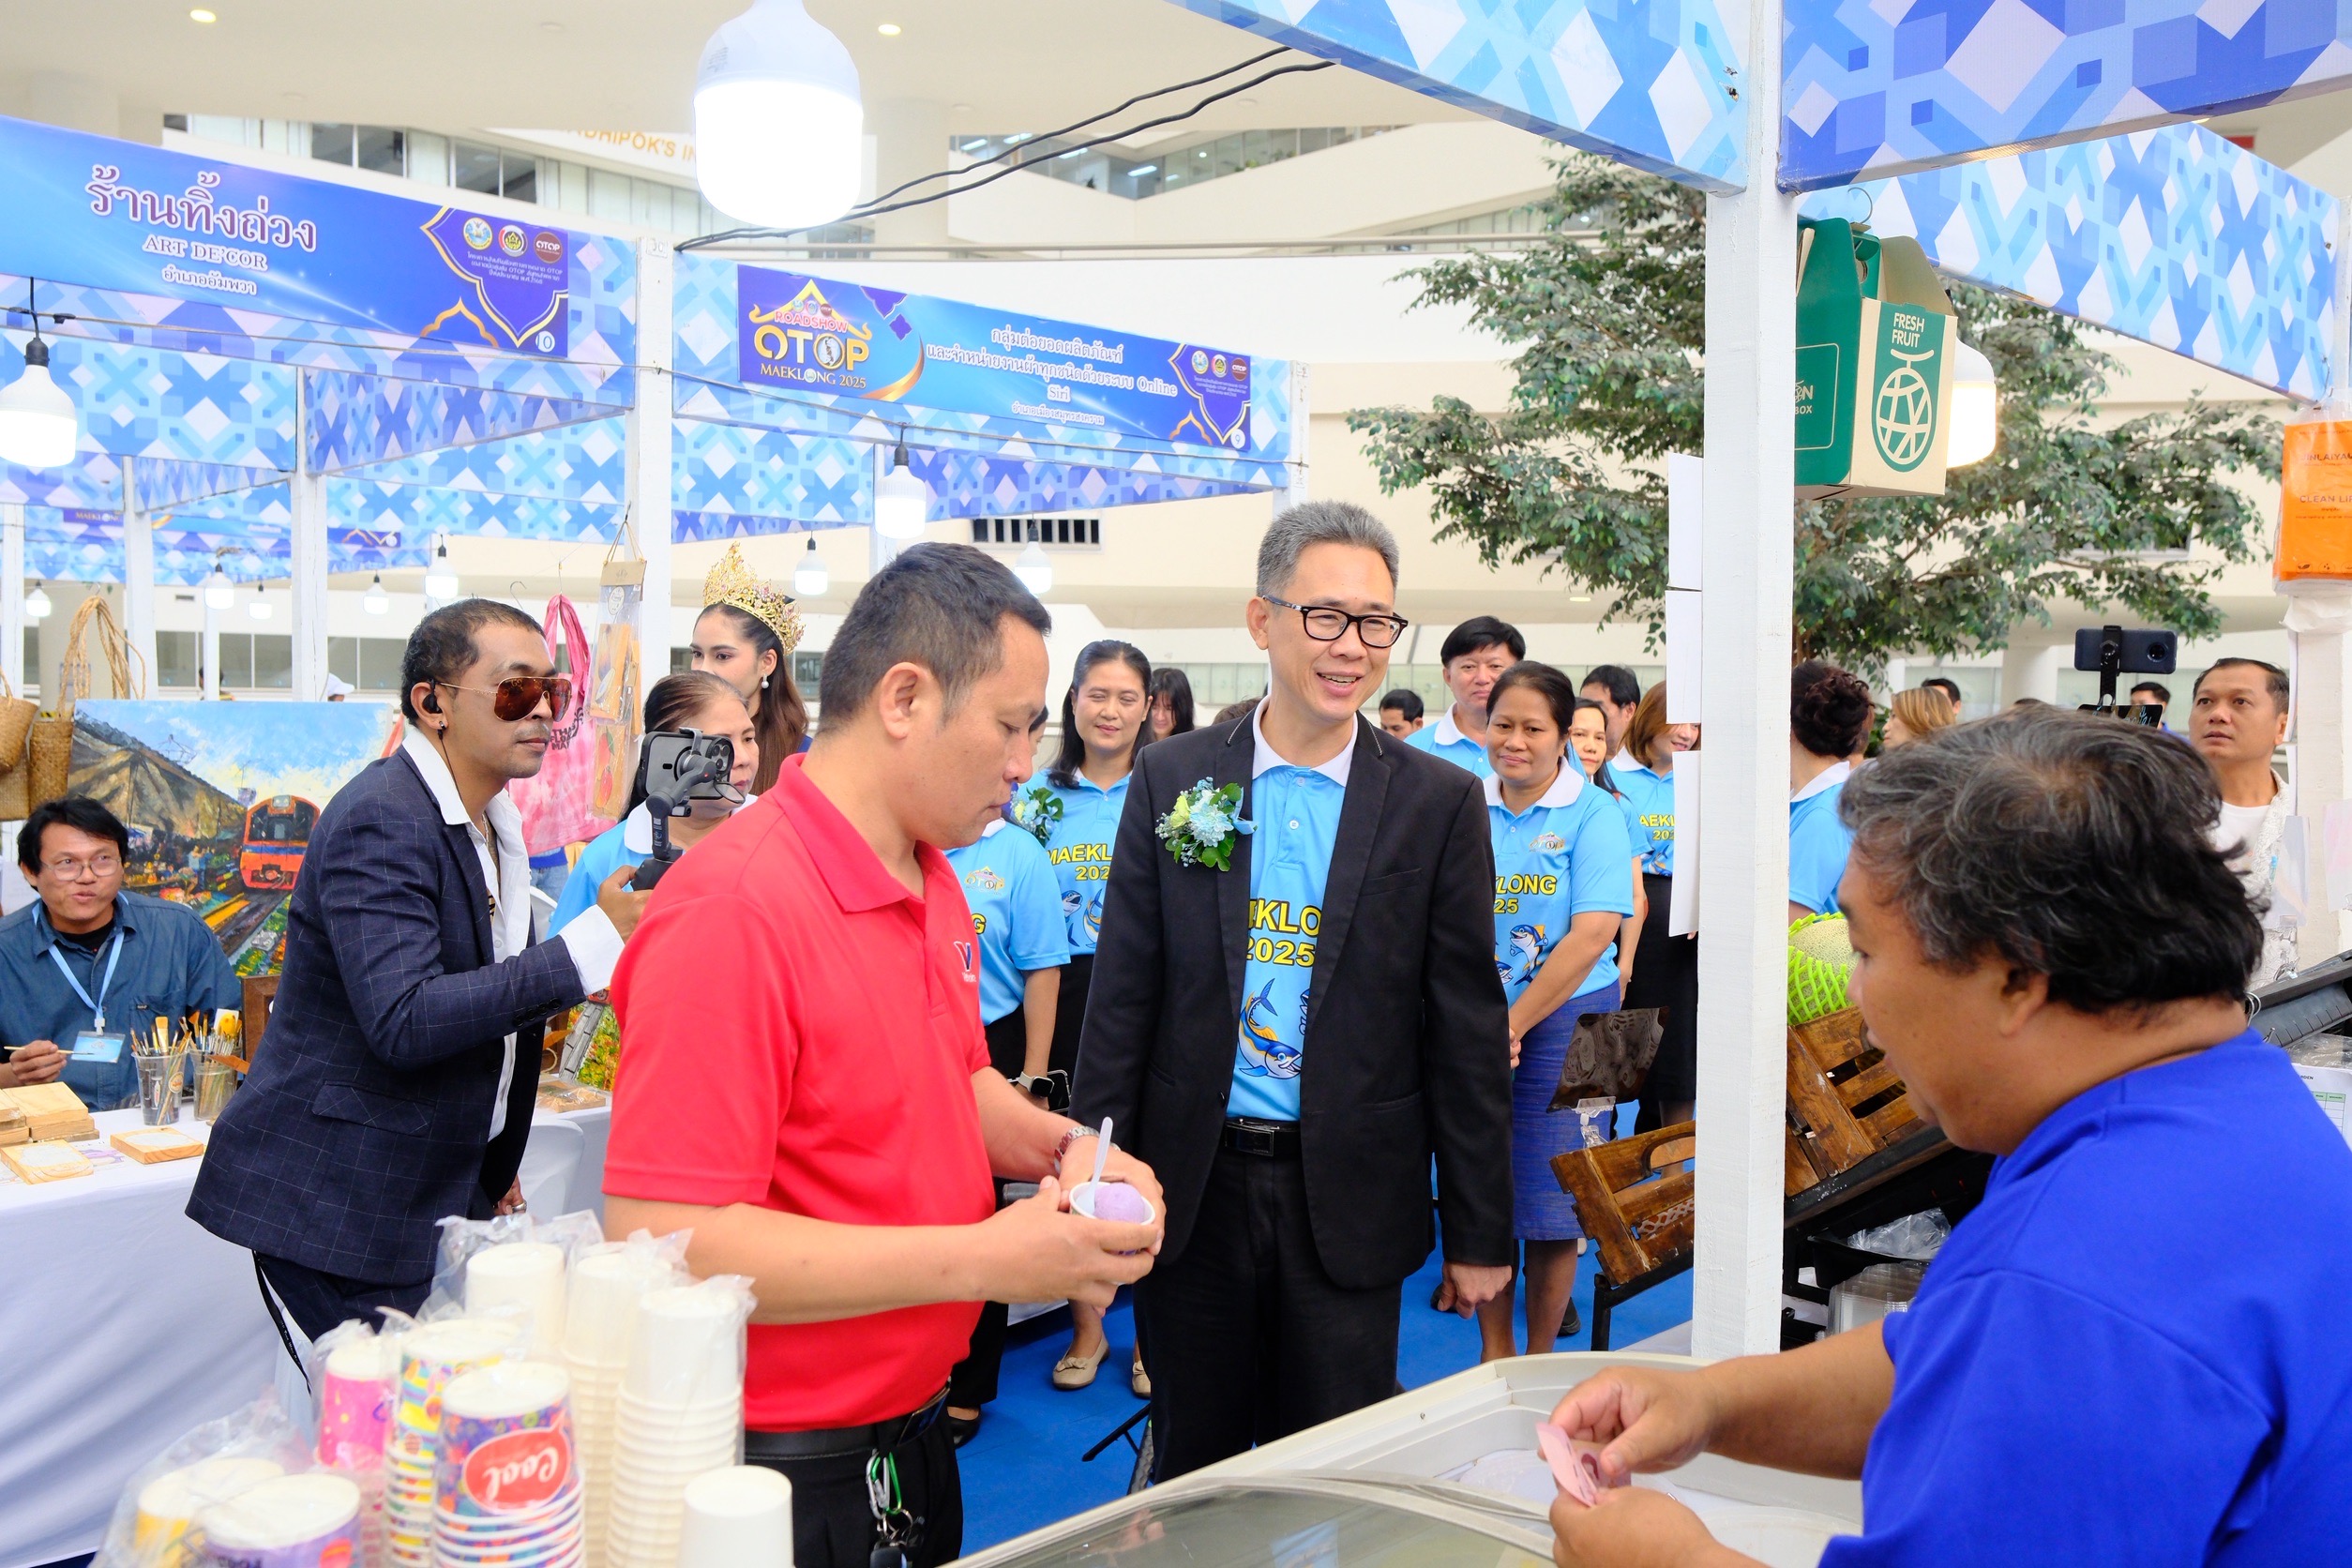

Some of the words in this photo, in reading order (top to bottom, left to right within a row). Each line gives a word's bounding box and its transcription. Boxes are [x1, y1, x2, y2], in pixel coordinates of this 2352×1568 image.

[87, 166, 317, 251] ร้านทิ้งถ่วง
[145, 235, 187, 255] ART
[192, 244, 268, 270] DE'COR
[535, 240, 561, 251] OTOP
[162, 264, 258, 295] อำเภออัมพวา
[775, 310, 849, 332] ROADSHOW
[1893, 312, 1924, 332] FRESH
[754, 324, 870, 371] OTOP
[991, 325, 1123, 364] กลุ่มต่อยอดผลิตภัณฑ์
[1892, 329, 1920, 347] FRUIT
[761, 363, 837, 384] MAEKLONG
[839, 375, 867, 389] 2025
[927, 344, 1134, 390] และจำหน่ายงานผ้าทุกชนิดด้วยระบบ
[1138, 376, 1178, 398] Online
[1048, 384, 1071, 402] Siri
[2300, 495, 2335, 504] CLEAN
[482, 1447, 559, 1501] Cool
